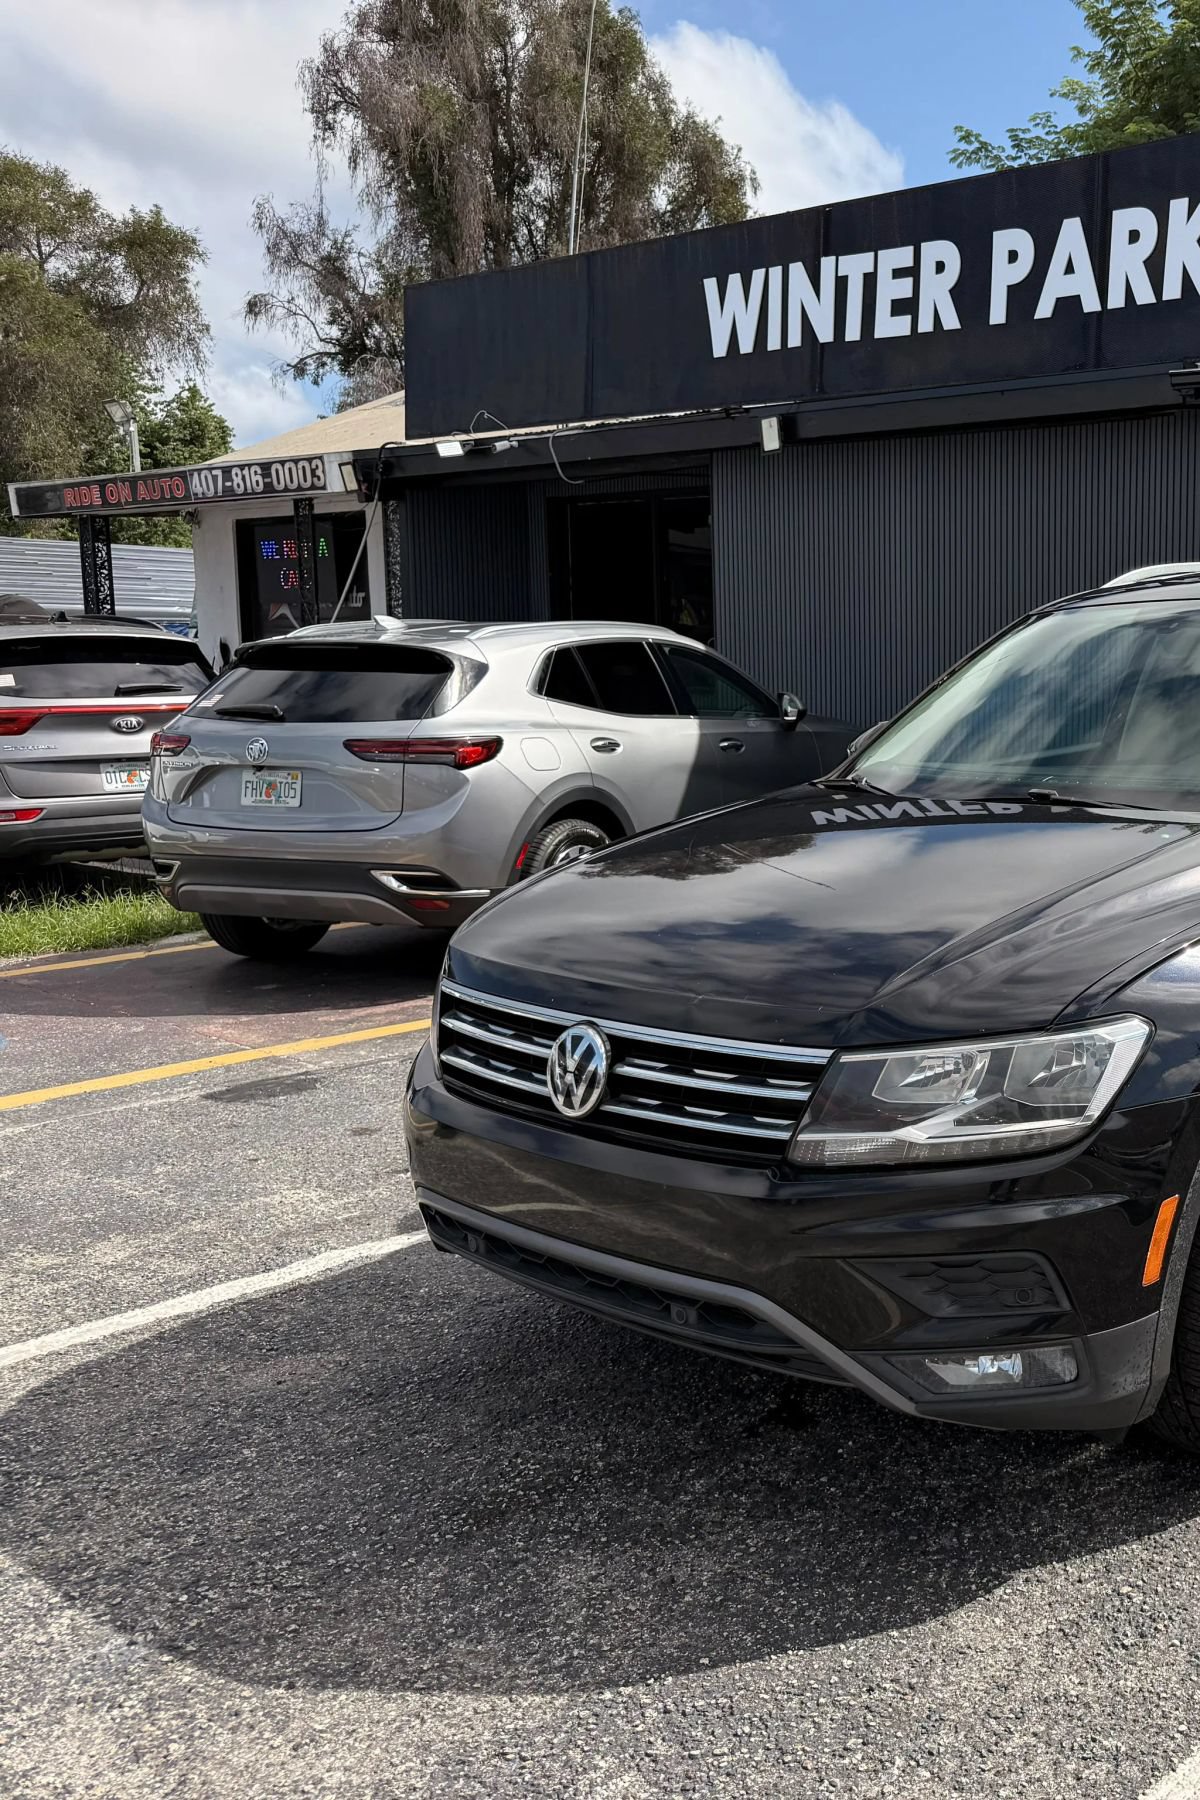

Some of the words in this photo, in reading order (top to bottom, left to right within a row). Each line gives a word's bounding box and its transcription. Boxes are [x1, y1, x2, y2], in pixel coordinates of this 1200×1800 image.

[703, 241, 961, 358] WINTER
[63, 484, 102, 507] RIDE
[105, 481, 132, 503] ON
[137, 476, 186, 500] AUTO
[192, 459, 325, 498] 407-816-0003
[244, 780, 265, 798] FHV
